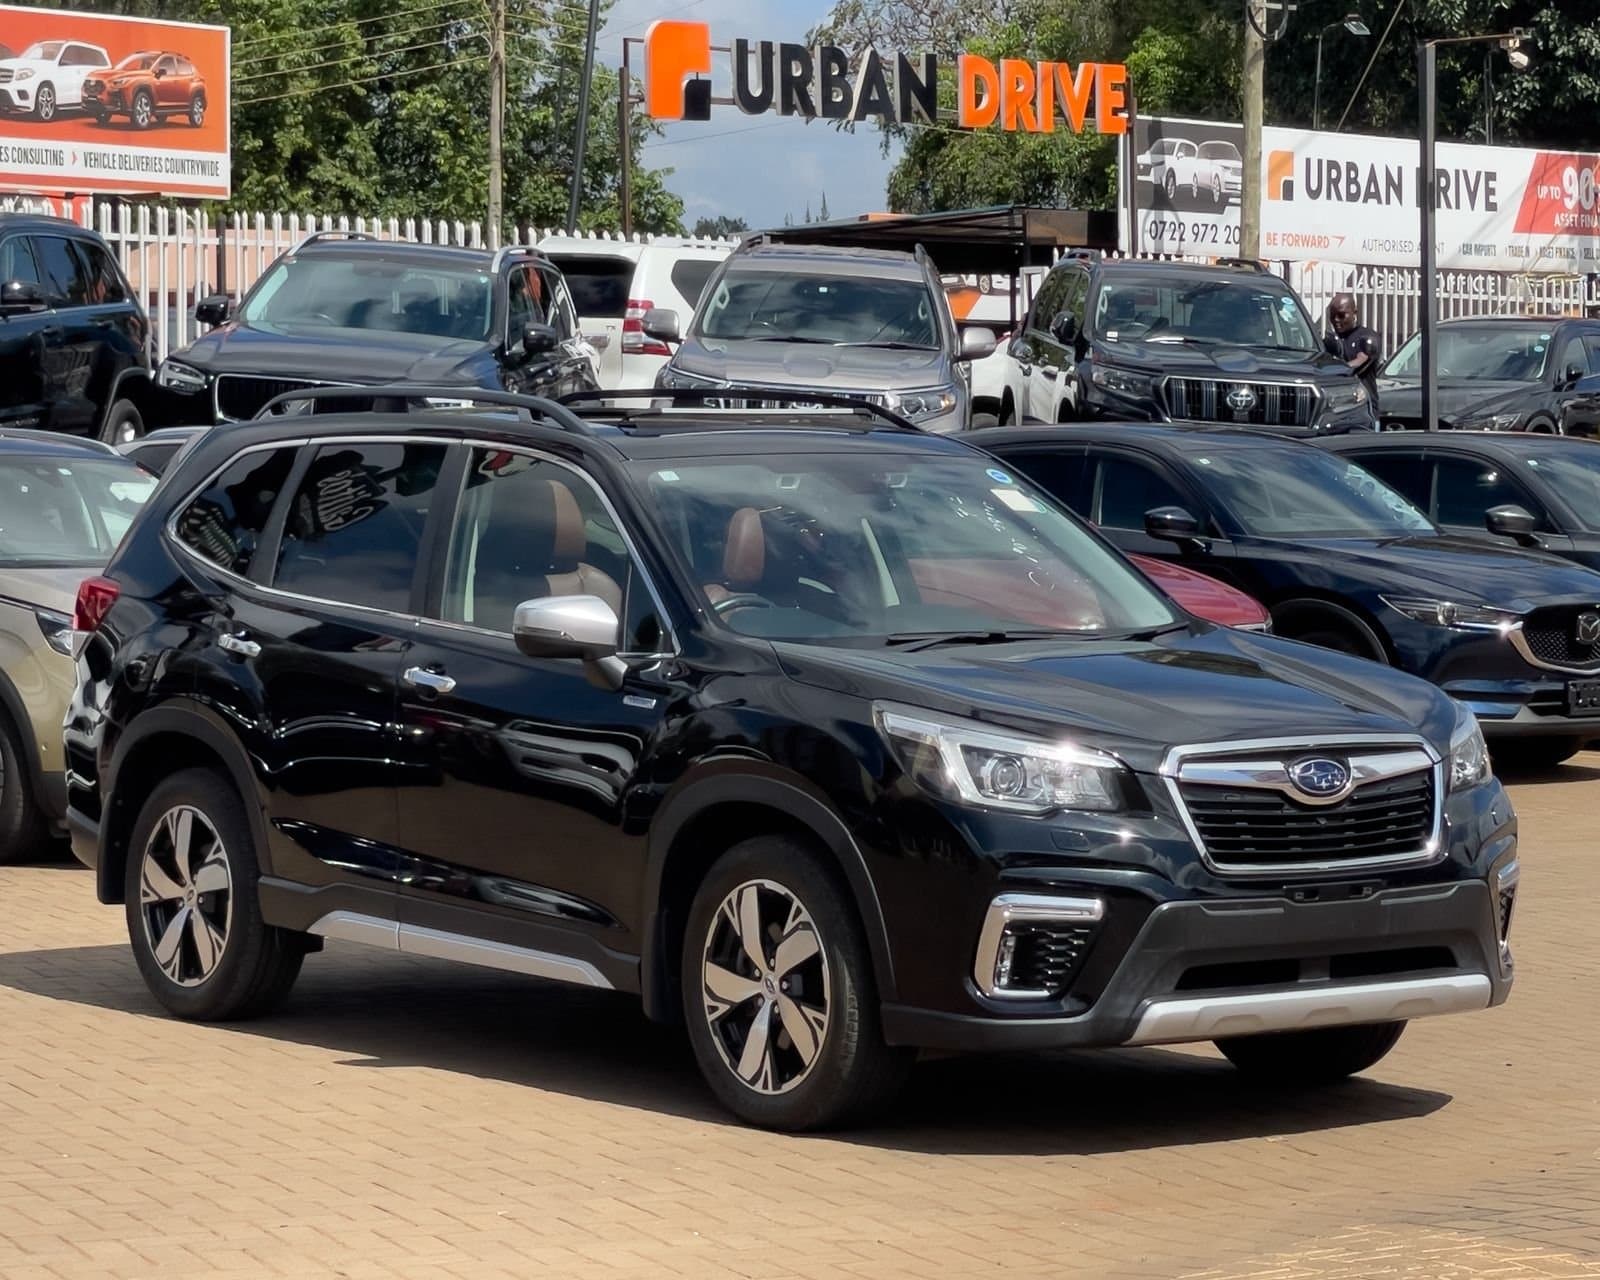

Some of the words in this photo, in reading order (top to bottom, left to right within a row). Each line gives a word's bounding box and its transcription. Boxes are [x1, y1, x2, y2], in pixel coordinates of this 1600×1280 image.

[730, 38, 938, 123] URBAN
[957, 54, 1127, 134] DRIVE
[0, 146, 10, 164] ES
[11, 146, 65, 166] CONSULTING
[83, 151, 117, 170] VEHICLE
[118, 153, 163, 173] DELIVERIES
[164, 157, 220, 177] COUNTRYWIDE
[1305, 157, 1403, 207] URBAN
[1537, 184, 1548, 200] UP
[1549, 185, 1561, 200] TO
[1563, 166, 1600, 211] 90
[1149, 220, 1186, 242] 0722
[1191, 222, 1218, 244] 972
[1553, 212, 1578, 228] ASSET
[1580, 213, 1600, 230] FINA
[1266, 232, 1277, 246] BE
[1281, 232, 1330, 249] FORWARD
[1362, 238, 1415, 253] AUTHORISED
